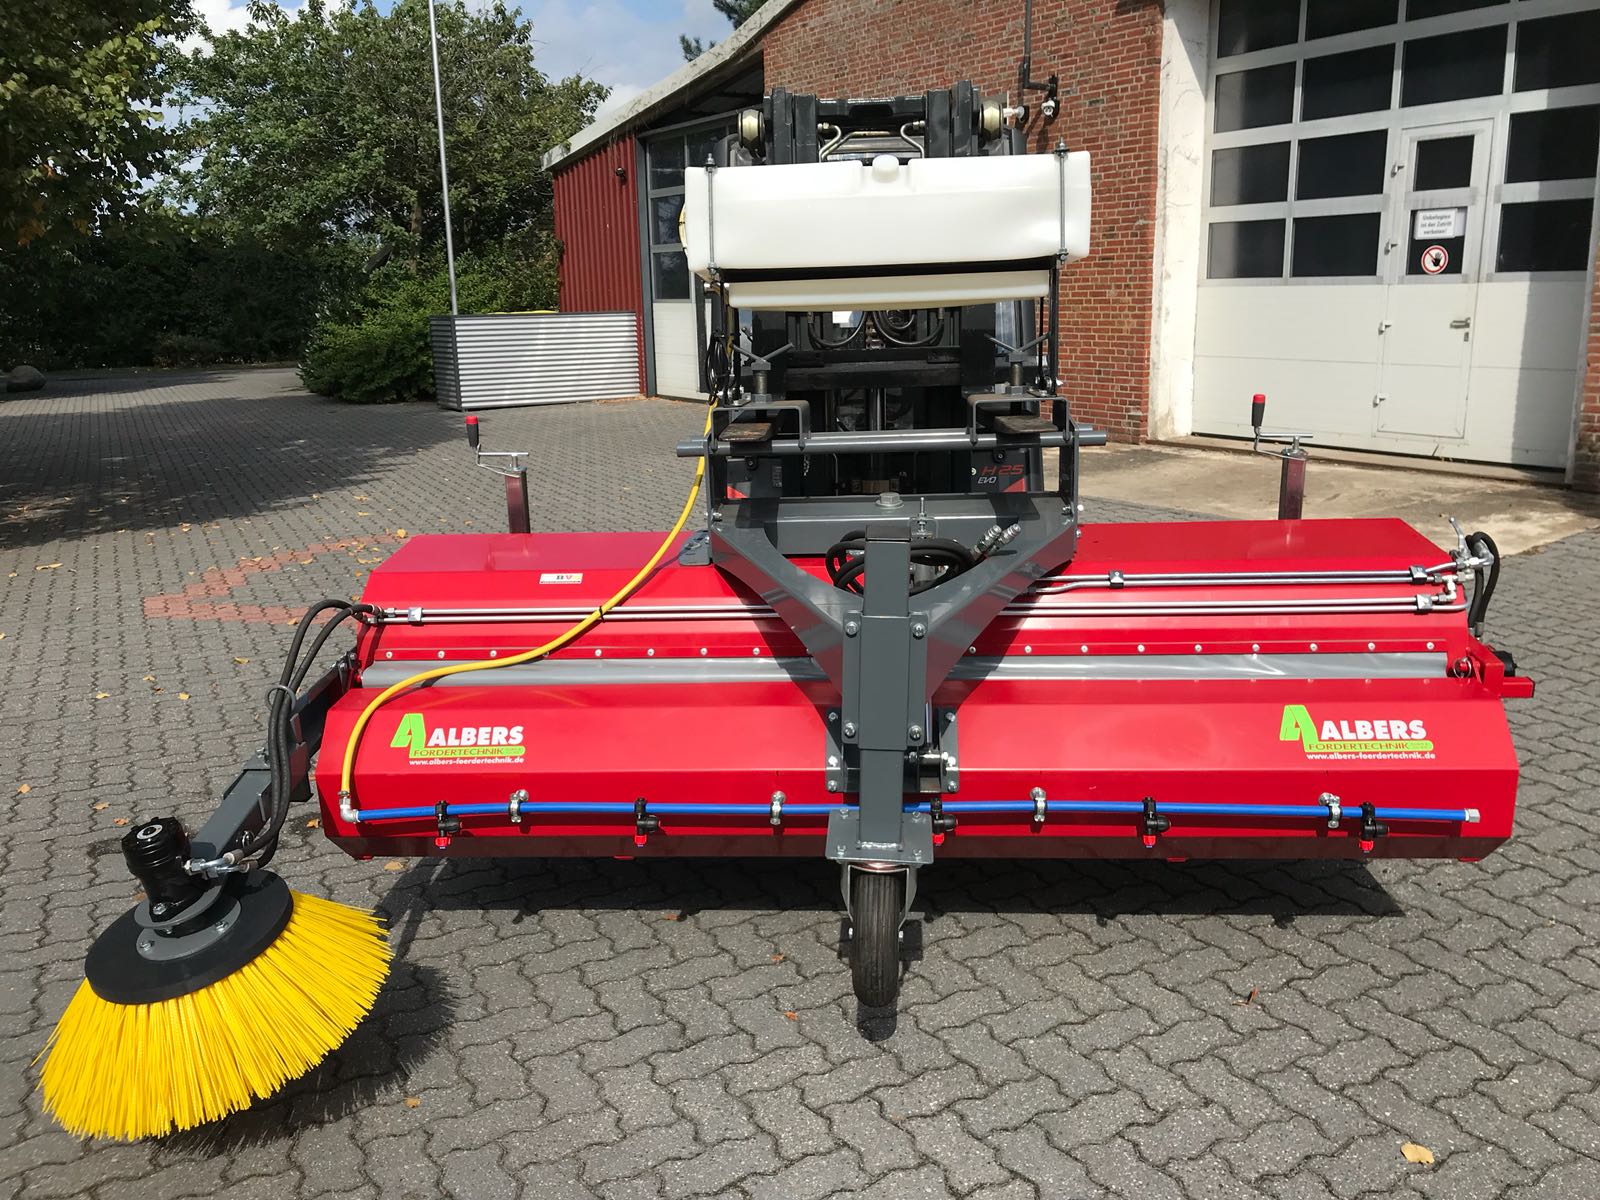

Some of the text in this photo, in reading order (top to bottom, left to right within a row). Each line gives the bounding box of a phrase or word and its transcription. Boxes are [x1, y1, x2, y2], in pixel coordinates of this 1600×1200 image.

[978, 476, 997, 484] EVO
[1320, 720, 1427, 740] ALBERS
[427, 726, 524, 746] ALBERS
[409, 756, 524, 766] www.albers-foerdertechnik.de
[1306, 752, 1436, 760] www.albers-foerdertechnik.de
